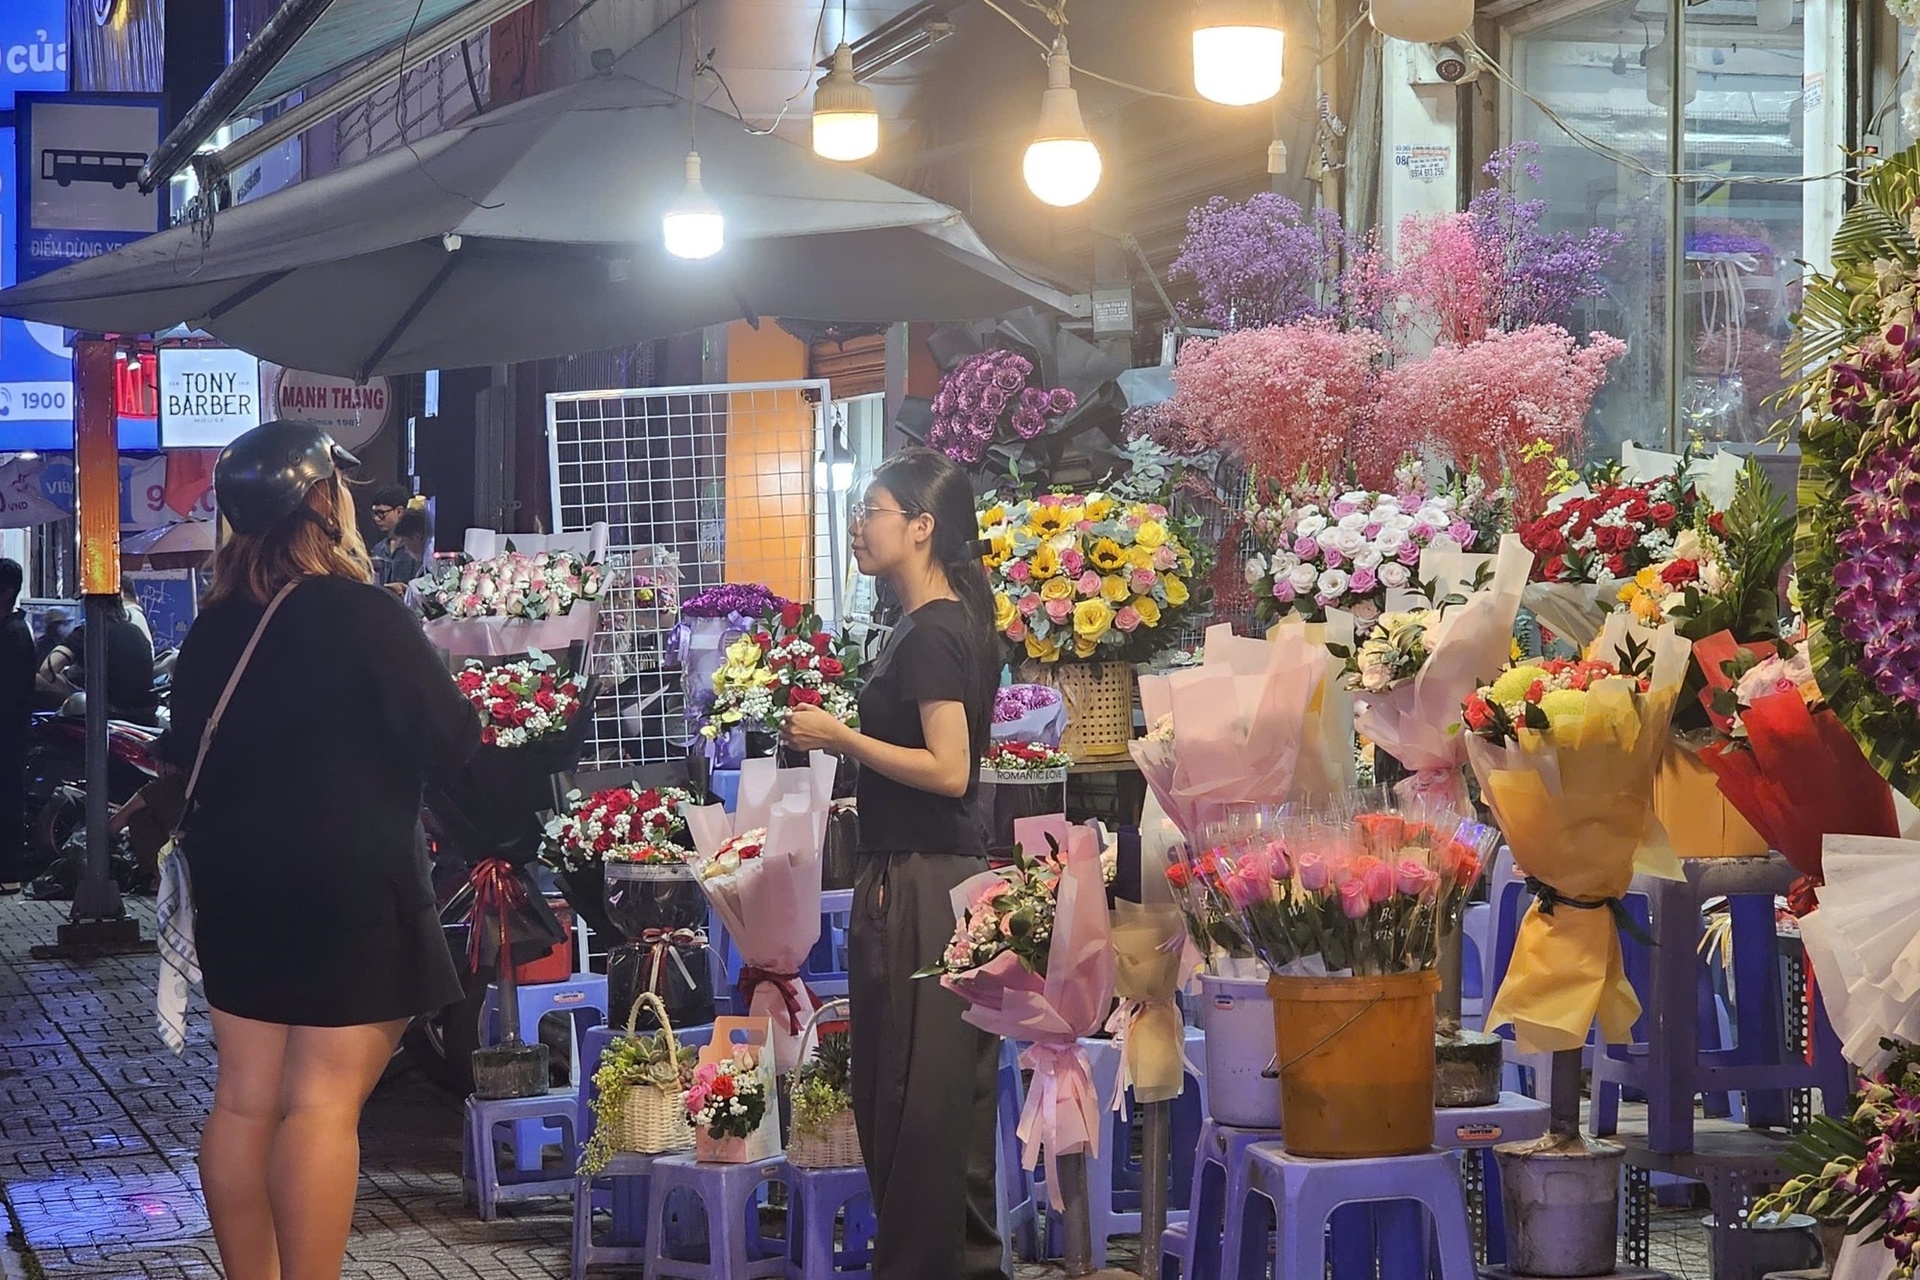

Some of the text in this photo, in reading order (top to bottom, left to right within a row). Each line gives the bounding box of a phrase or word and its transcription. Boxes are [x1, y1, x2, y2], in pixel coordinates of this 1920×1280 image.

[31, 233, 62, 257] ĐIỂM
[65, 237, 102, 258] DỪNG
[182, 372, 237, 393] TONY
[21, 392, 65, 409] 1900
[169, 395, 251, 416] BARBER
[282, 386, 326, 413] MẠNH
[997, 769, 1062, 780] ROMANTIC LOVE
